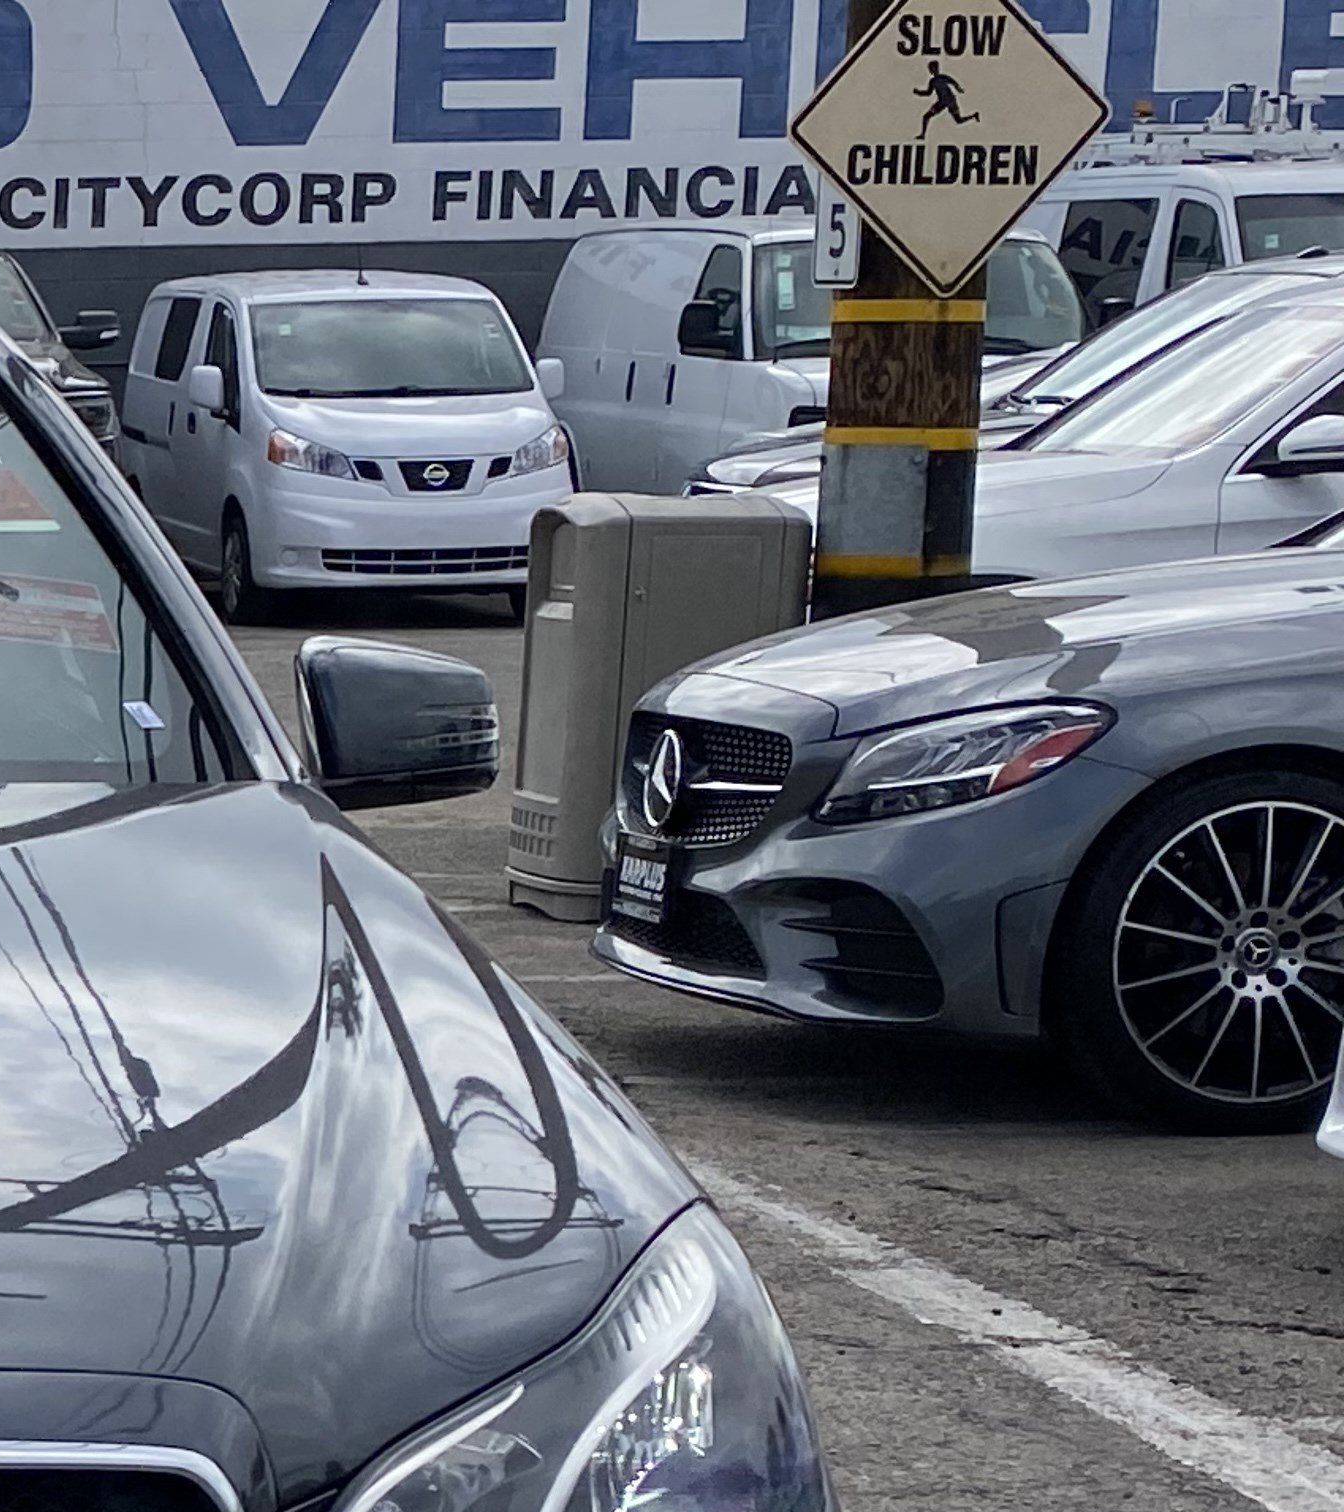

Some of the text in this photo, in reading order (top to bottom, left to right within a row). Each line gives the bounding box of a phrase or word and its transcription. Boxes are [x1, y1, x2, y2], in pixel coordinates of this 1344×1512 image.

[896, 15, 1007, 56] SLOW
[847, 143, 1039, 186] CHILDREN
[829, 204, 846, 258] 5
